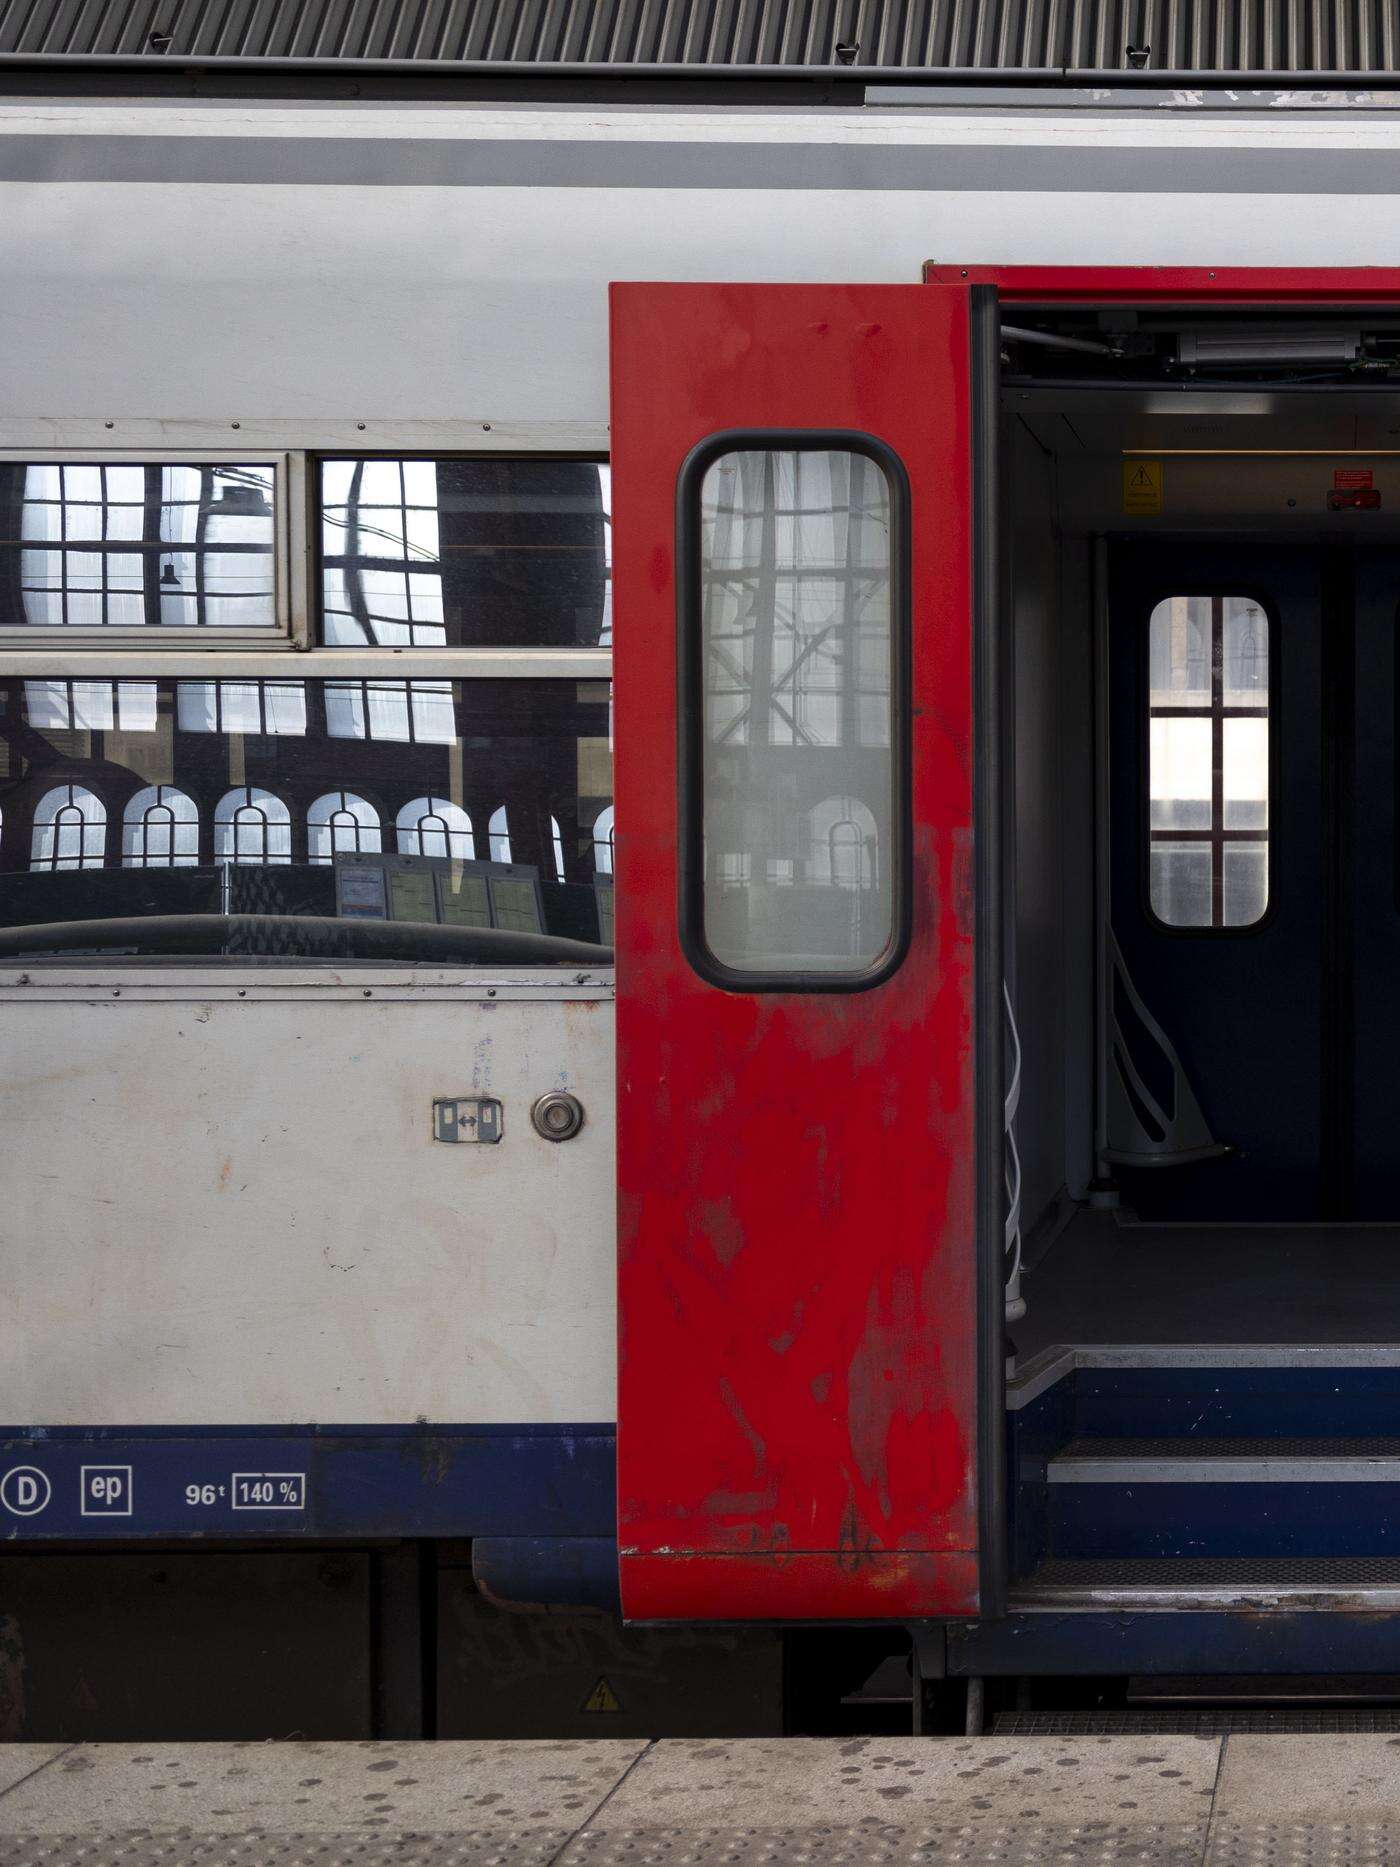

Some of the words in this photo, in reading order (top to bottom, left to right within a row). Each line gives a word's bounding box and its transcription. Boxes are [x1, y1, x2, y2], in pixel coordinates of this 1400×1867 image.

[18, 1476, 37, 1505] D
[91, 1476, 122, 1504] ep
[239, 1482, 273, 1502] 140
